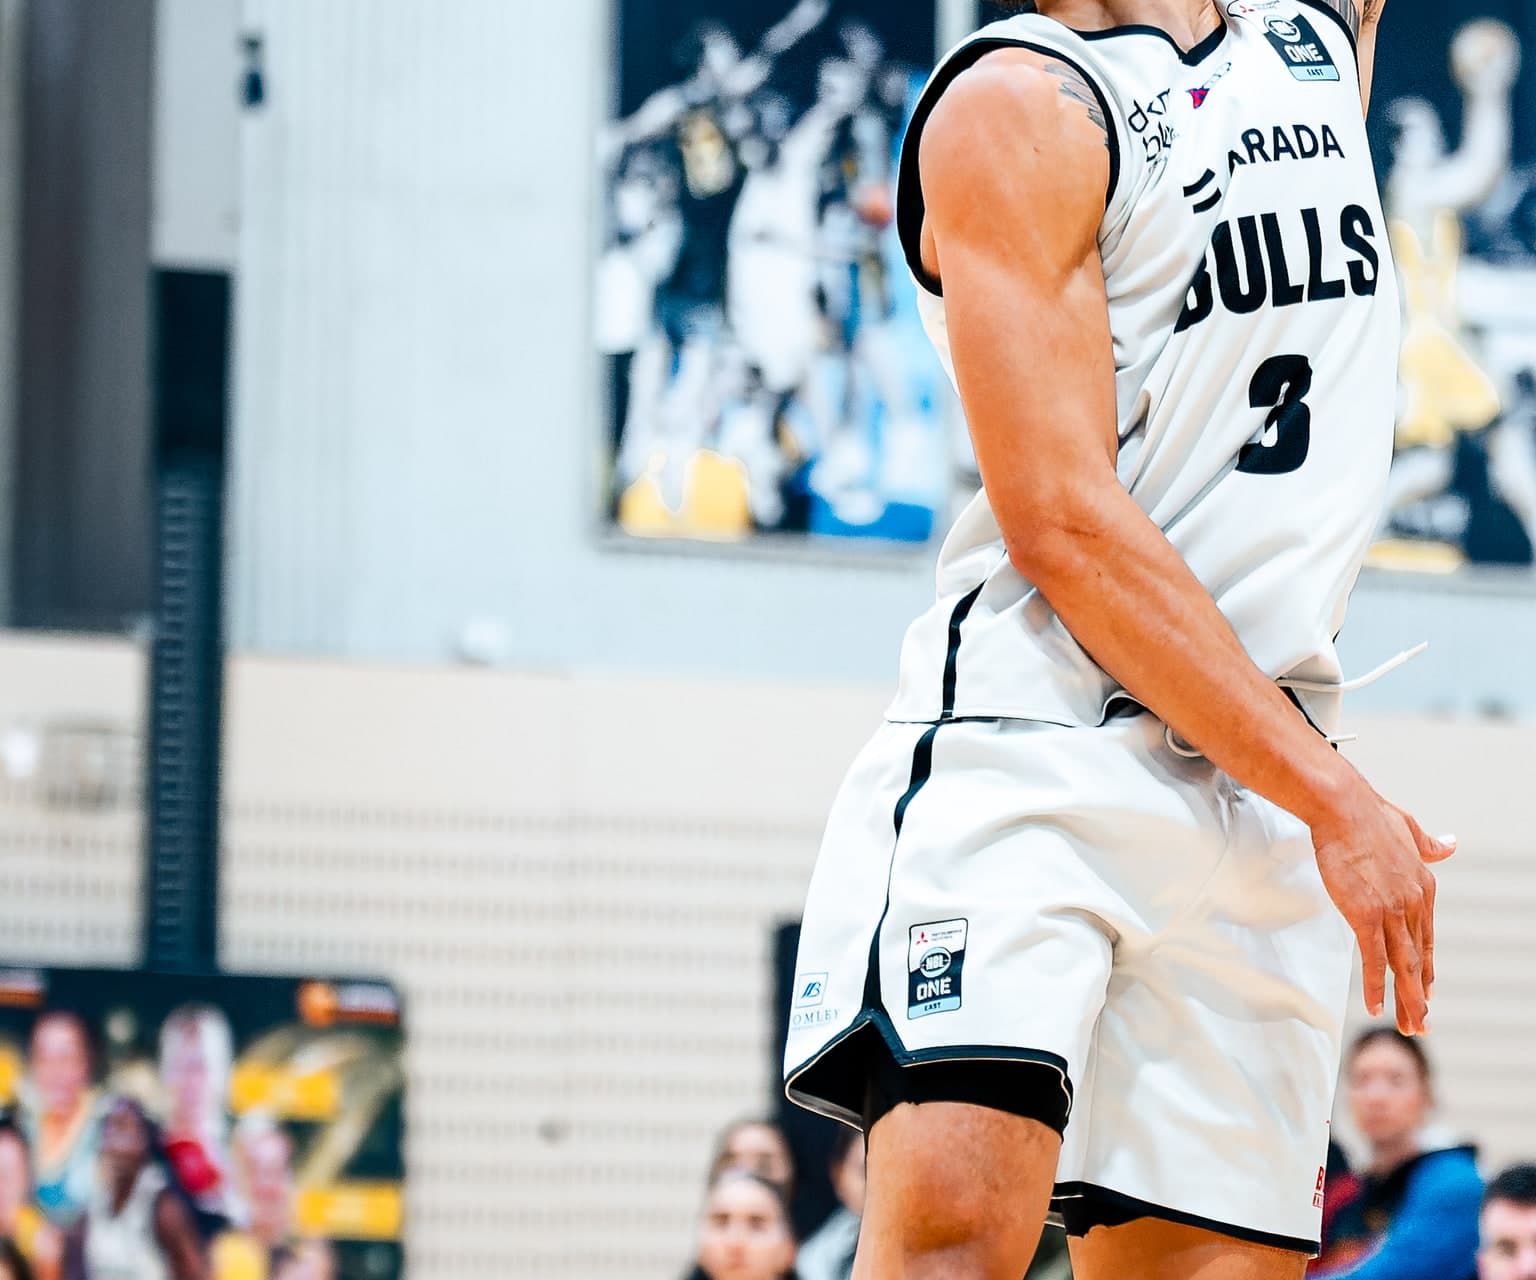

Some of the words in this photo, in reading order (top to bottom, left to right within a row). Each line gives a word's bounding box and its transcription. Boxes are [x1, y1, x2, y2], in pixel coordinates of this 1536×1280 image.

[1283, 42, 1325, 64] ONE
[1173, 203, 1380, 335] BULLS
[1234, 353, 1314, 476] 3
[916, 975, 953, 1001] ONE
